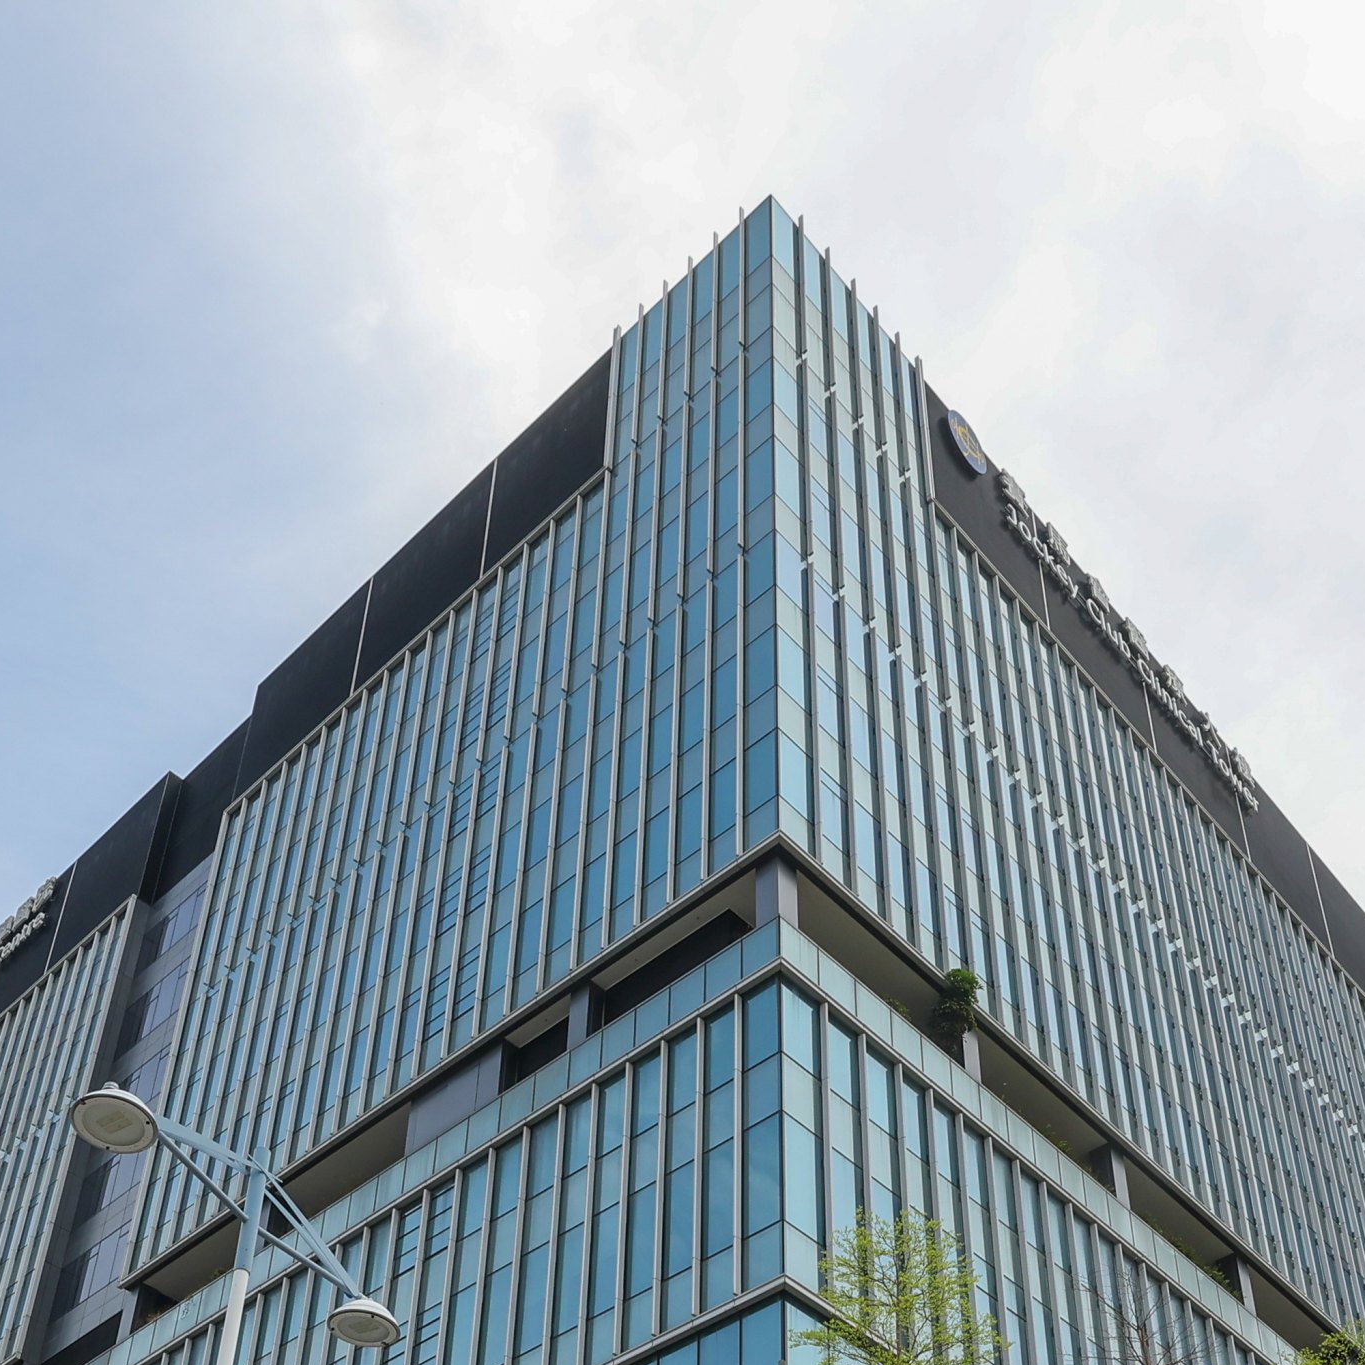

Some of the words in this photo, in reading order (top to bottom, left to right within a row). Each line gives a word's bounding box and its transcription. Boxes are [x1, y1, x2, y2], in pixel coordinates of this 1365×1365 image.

[1004, 503, 1078, 598] Jockey
[1086, 598, 1131, 659] Club
[1137, 658, 1204, 747] Clinical
[1205, 740, 1259, 813] Tower
